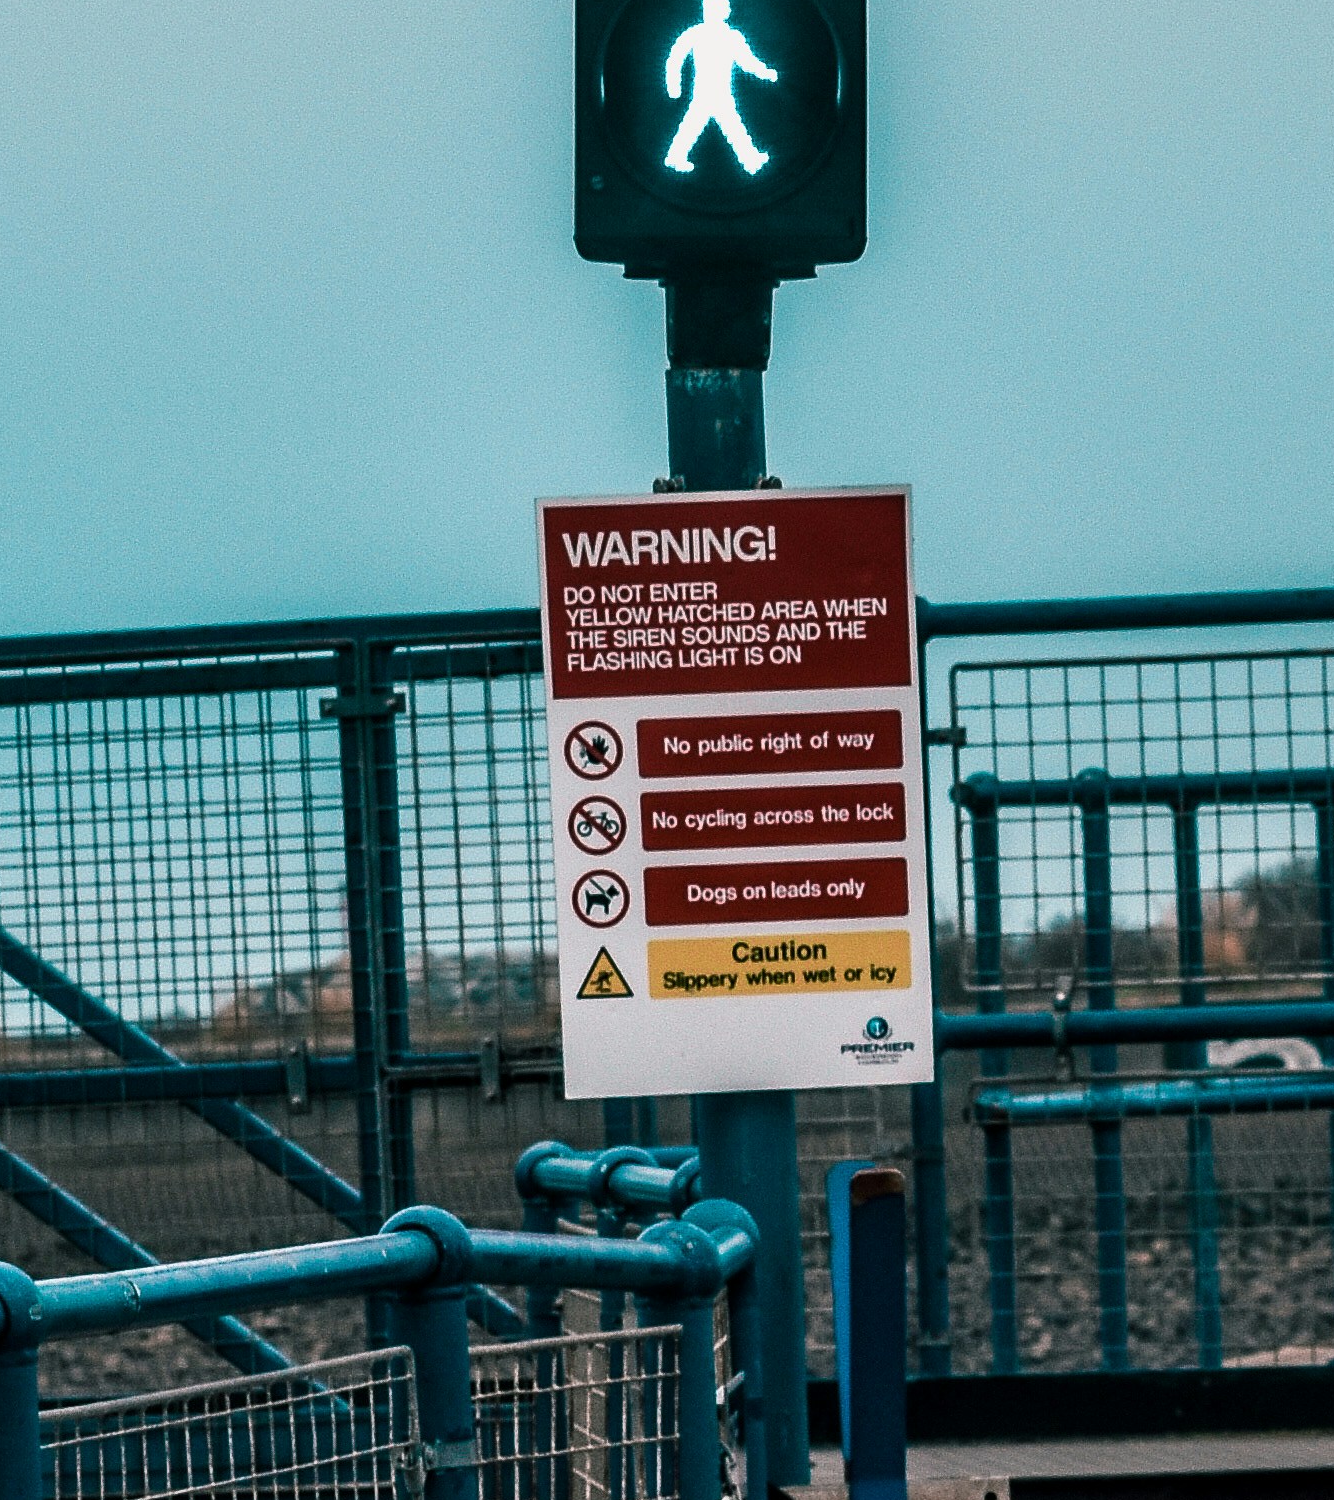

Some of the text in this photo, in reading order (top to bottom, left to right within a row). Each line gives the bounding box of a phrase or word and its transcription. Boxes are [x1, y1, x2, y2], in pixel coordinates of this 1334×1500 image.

[563, 526, 776, 567] WARNING!
[564, 583, 717, 605] DO NOT ENTER
[566, 598, 887, 627] YELLOW HATCHED AREA WHEN
[567, 621, 866, 649] THE SIREN SOUNDS AND THE
[567, 646, 801, 672] FLASHING LIGHT IS ON
[664, 731, 874, 756] No public right of way
[653, 804, 893, 829] No cycling across the lock
[687, 879, 865, 904] Dogs on leads only
[732, 940, 826, 963] Caution
[663, 964, 896, 990] Slippery when wet or icy
[840, 1042, 914, 1054] PREMIER
